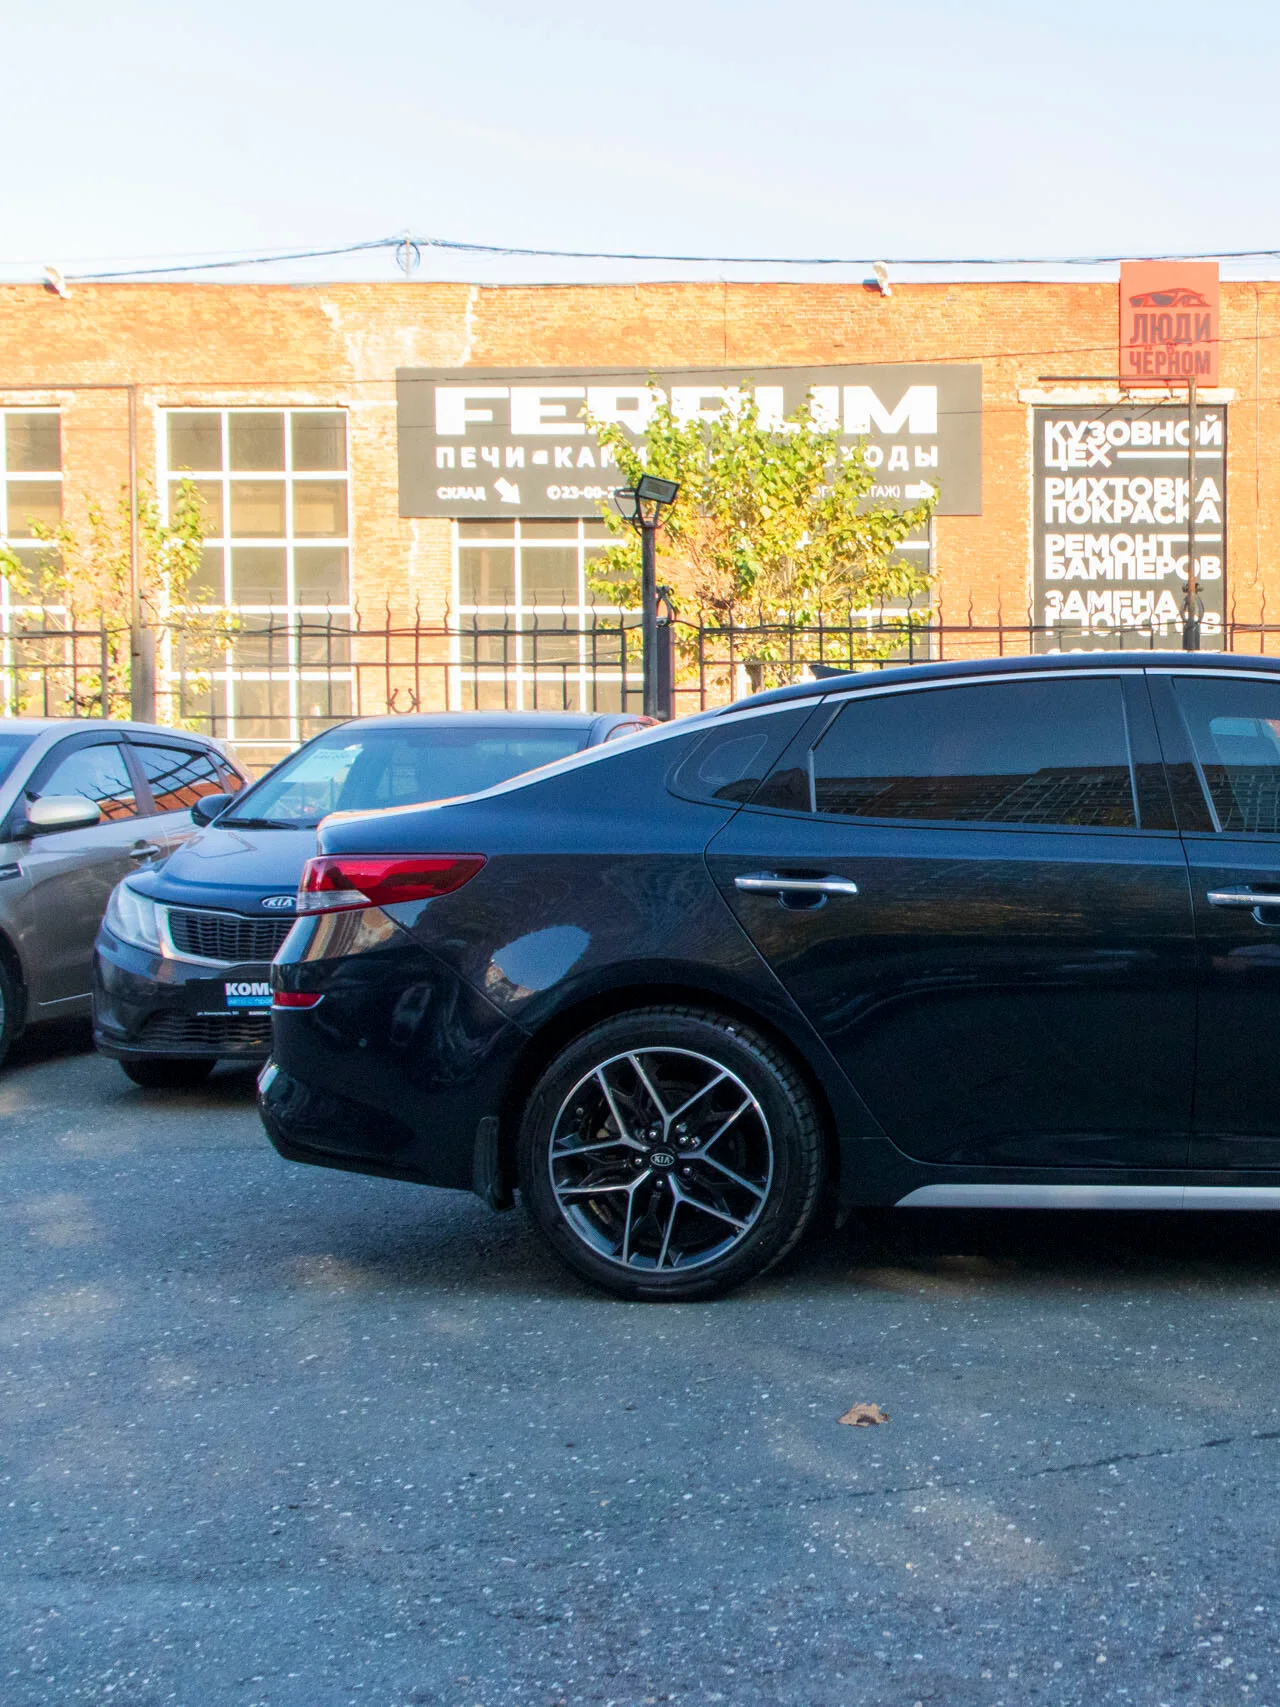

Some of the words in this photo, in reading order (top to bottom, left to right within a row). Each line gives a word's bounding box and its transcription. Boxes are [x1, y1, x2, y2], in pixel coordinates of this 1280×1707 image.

[1129, 313, 1211, 346] ЛЮДИ
[435, 385, 938, 435] FERRUM
[1044, 414, 1222, 446] КУЗОВНОЙ
[436, 446, 525, 468] ПЕЧИ
[1044, 442, 1112, 471] ЦЕХ
[436, 486, 487, 501] СКЛАД
[1044, 476, 1221, 502] РИХТОВКА
[1044, 499, 1221, 525] ПОКРАСКА
[1044, 533, 1176, 558] РЕМОНТ
[1044, 554, 1222, 581] БАМПЕРОВ
[1044, 589, 1180, 615] ЗАМЕНА
[225, 983, 274, 996] КОМ
